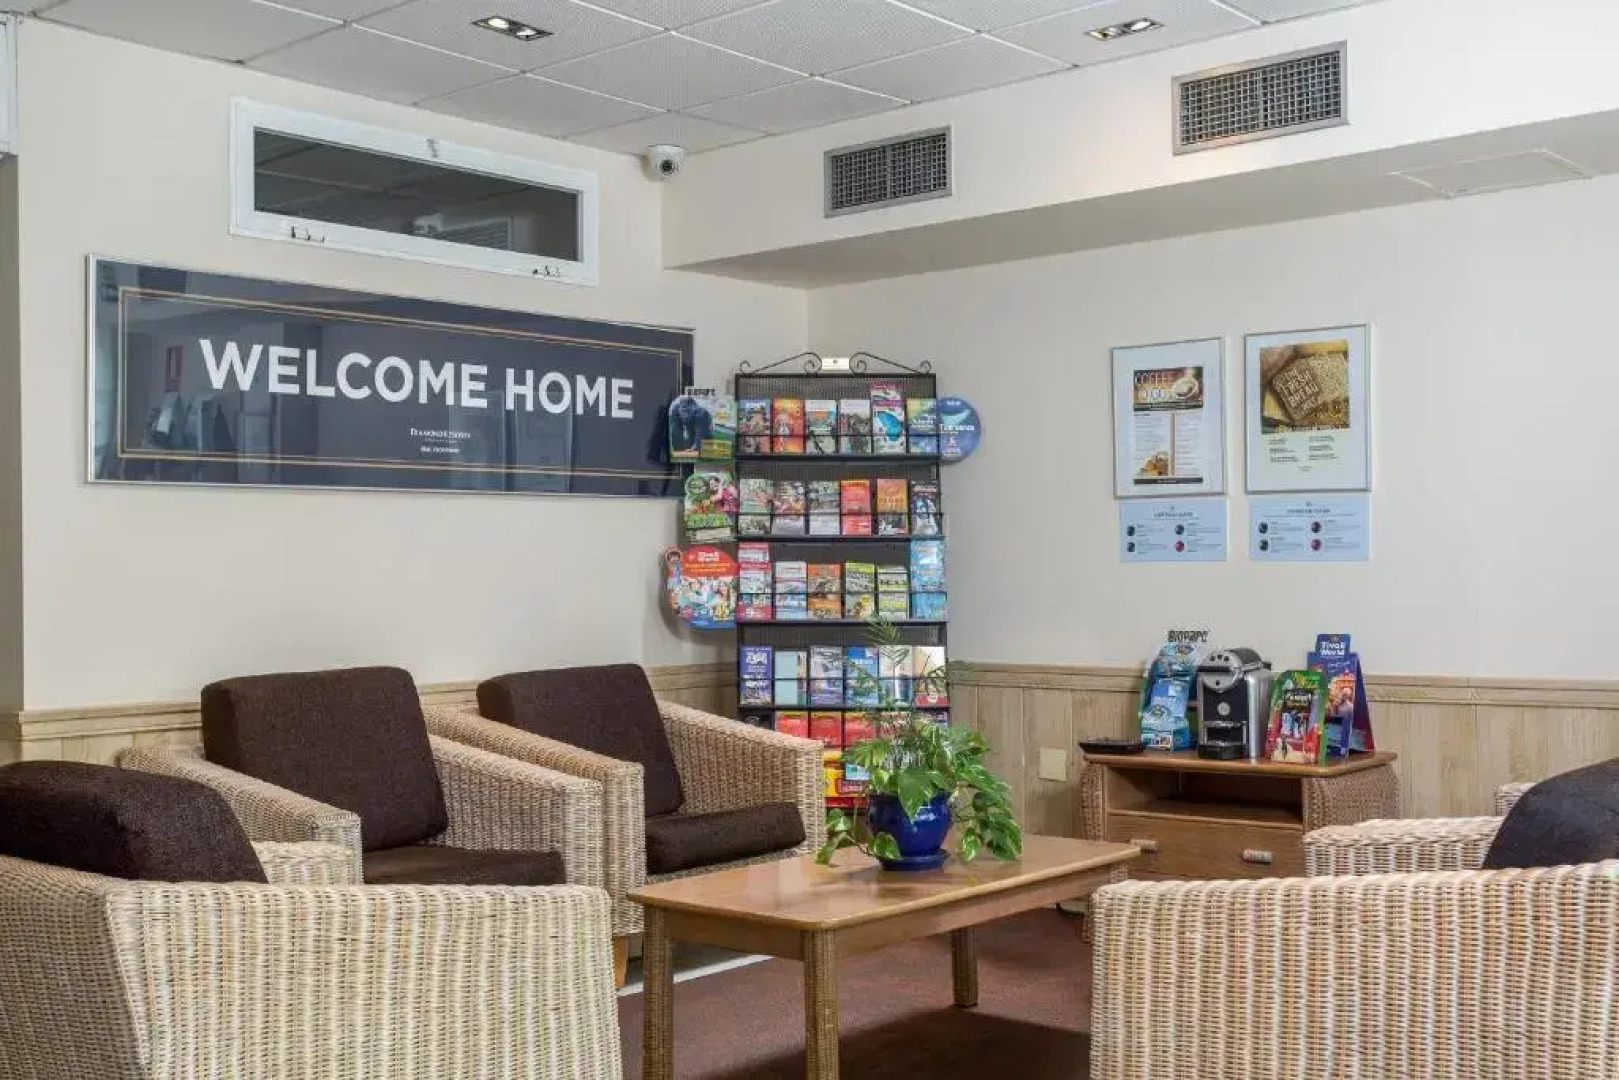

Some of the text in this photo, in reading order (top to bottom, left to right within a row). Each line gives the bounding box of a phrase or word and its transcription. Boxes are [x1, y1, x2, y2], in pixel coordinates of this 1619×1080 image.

[199, 338, 634, 419] WELCOME HOME
[1134, 371, 1174, 388] COFFEE
[1320, 641, 1346, 649] Tivoli
